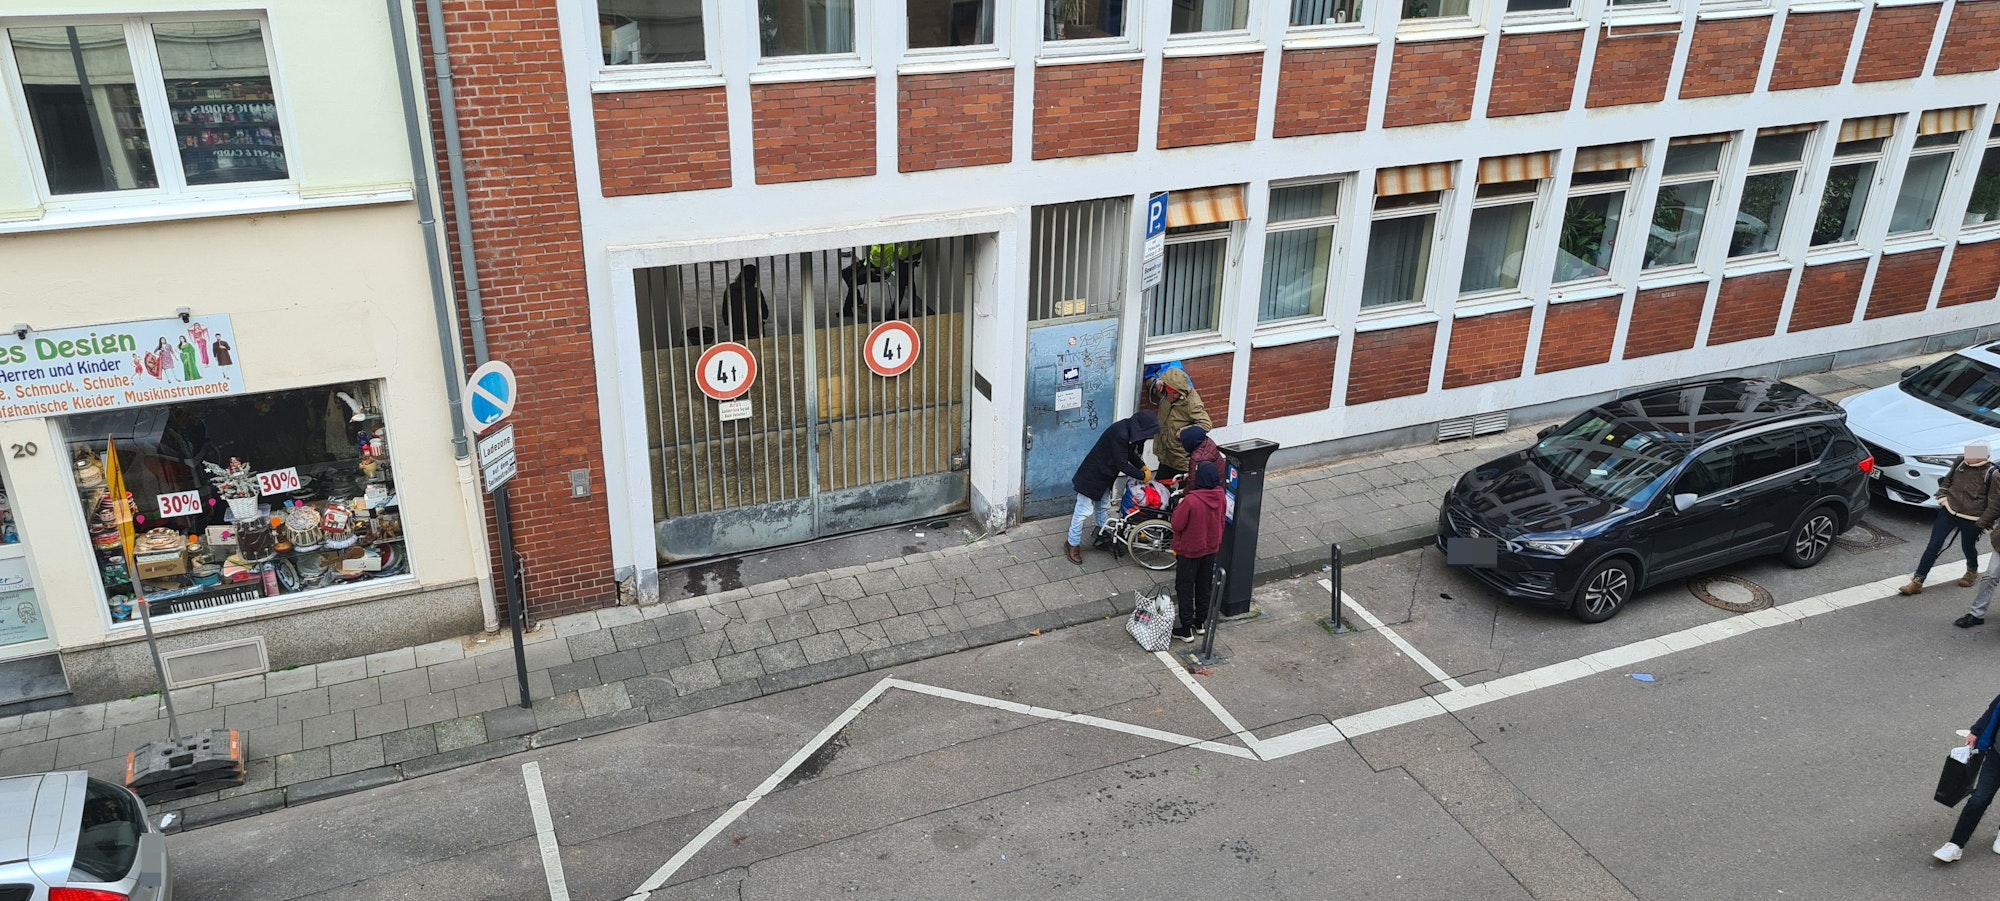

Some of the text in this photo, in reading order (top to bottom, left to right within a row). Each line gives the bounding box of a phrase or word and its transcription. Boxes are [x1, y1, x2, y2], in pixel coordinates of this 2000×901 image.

[1149, 201, 1163, 234] P
[35, 332, 136, 361] Design
[0, 359, 121, 383] Herren und Kinder
[15, 379, 79, 398] Schmuck,
[83, 375, 135, 391] Schuhe,
[0, 399, 69, 418] fghanische
[124, 381, 230, 404] Musikinstrumente
[11, 441, 38, 459] 20
[484, 437, 510, 457] Ladezone
[260, 470, 298, 493] 30%
[160, 493, 200, 515] 30%
